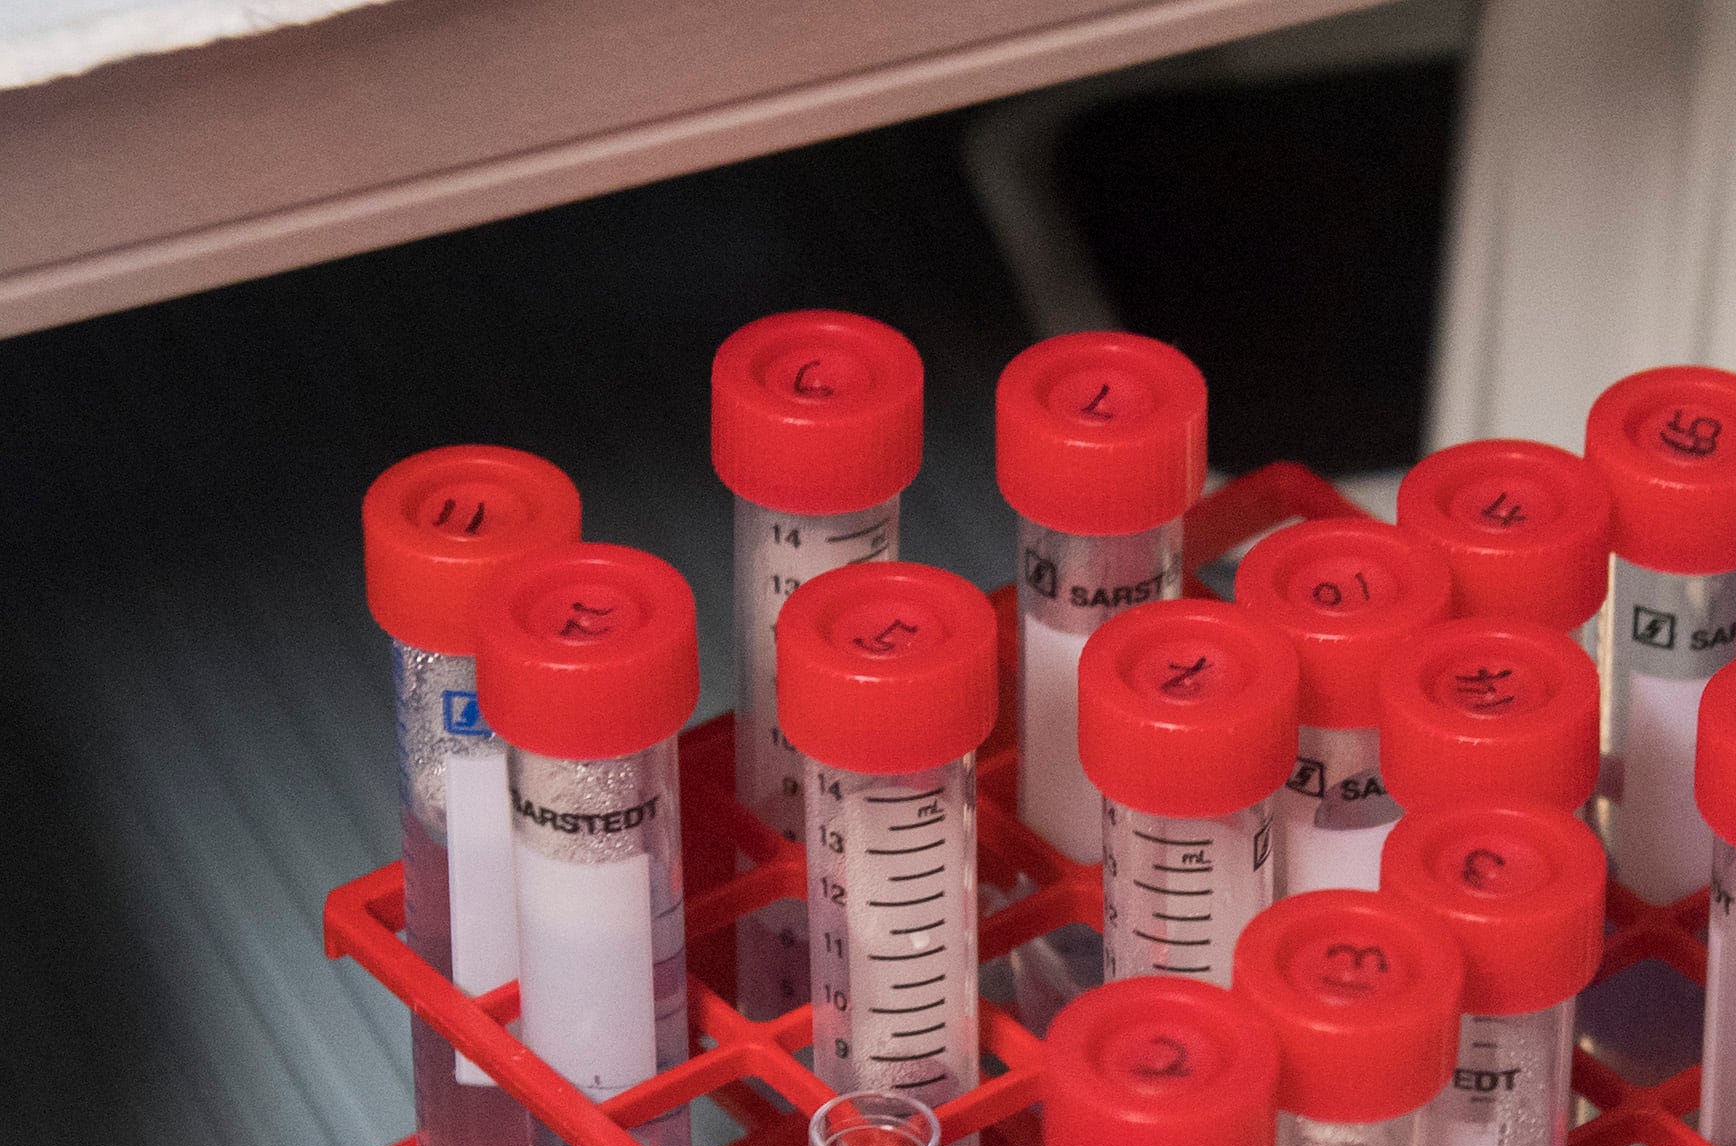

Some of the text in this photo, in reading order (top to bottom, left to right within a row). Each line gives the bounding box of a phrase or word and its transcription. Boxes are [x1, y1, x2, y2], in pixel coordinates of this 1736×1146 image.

[773, 523, 801, 548] 14
[818, 773, 842, 801] 14
[819, 824, 844, 854] 13
[821, 876, 846, 906] 12
[824, 932, 843, 959] 11
[825, 984, 847, 1012] 10
